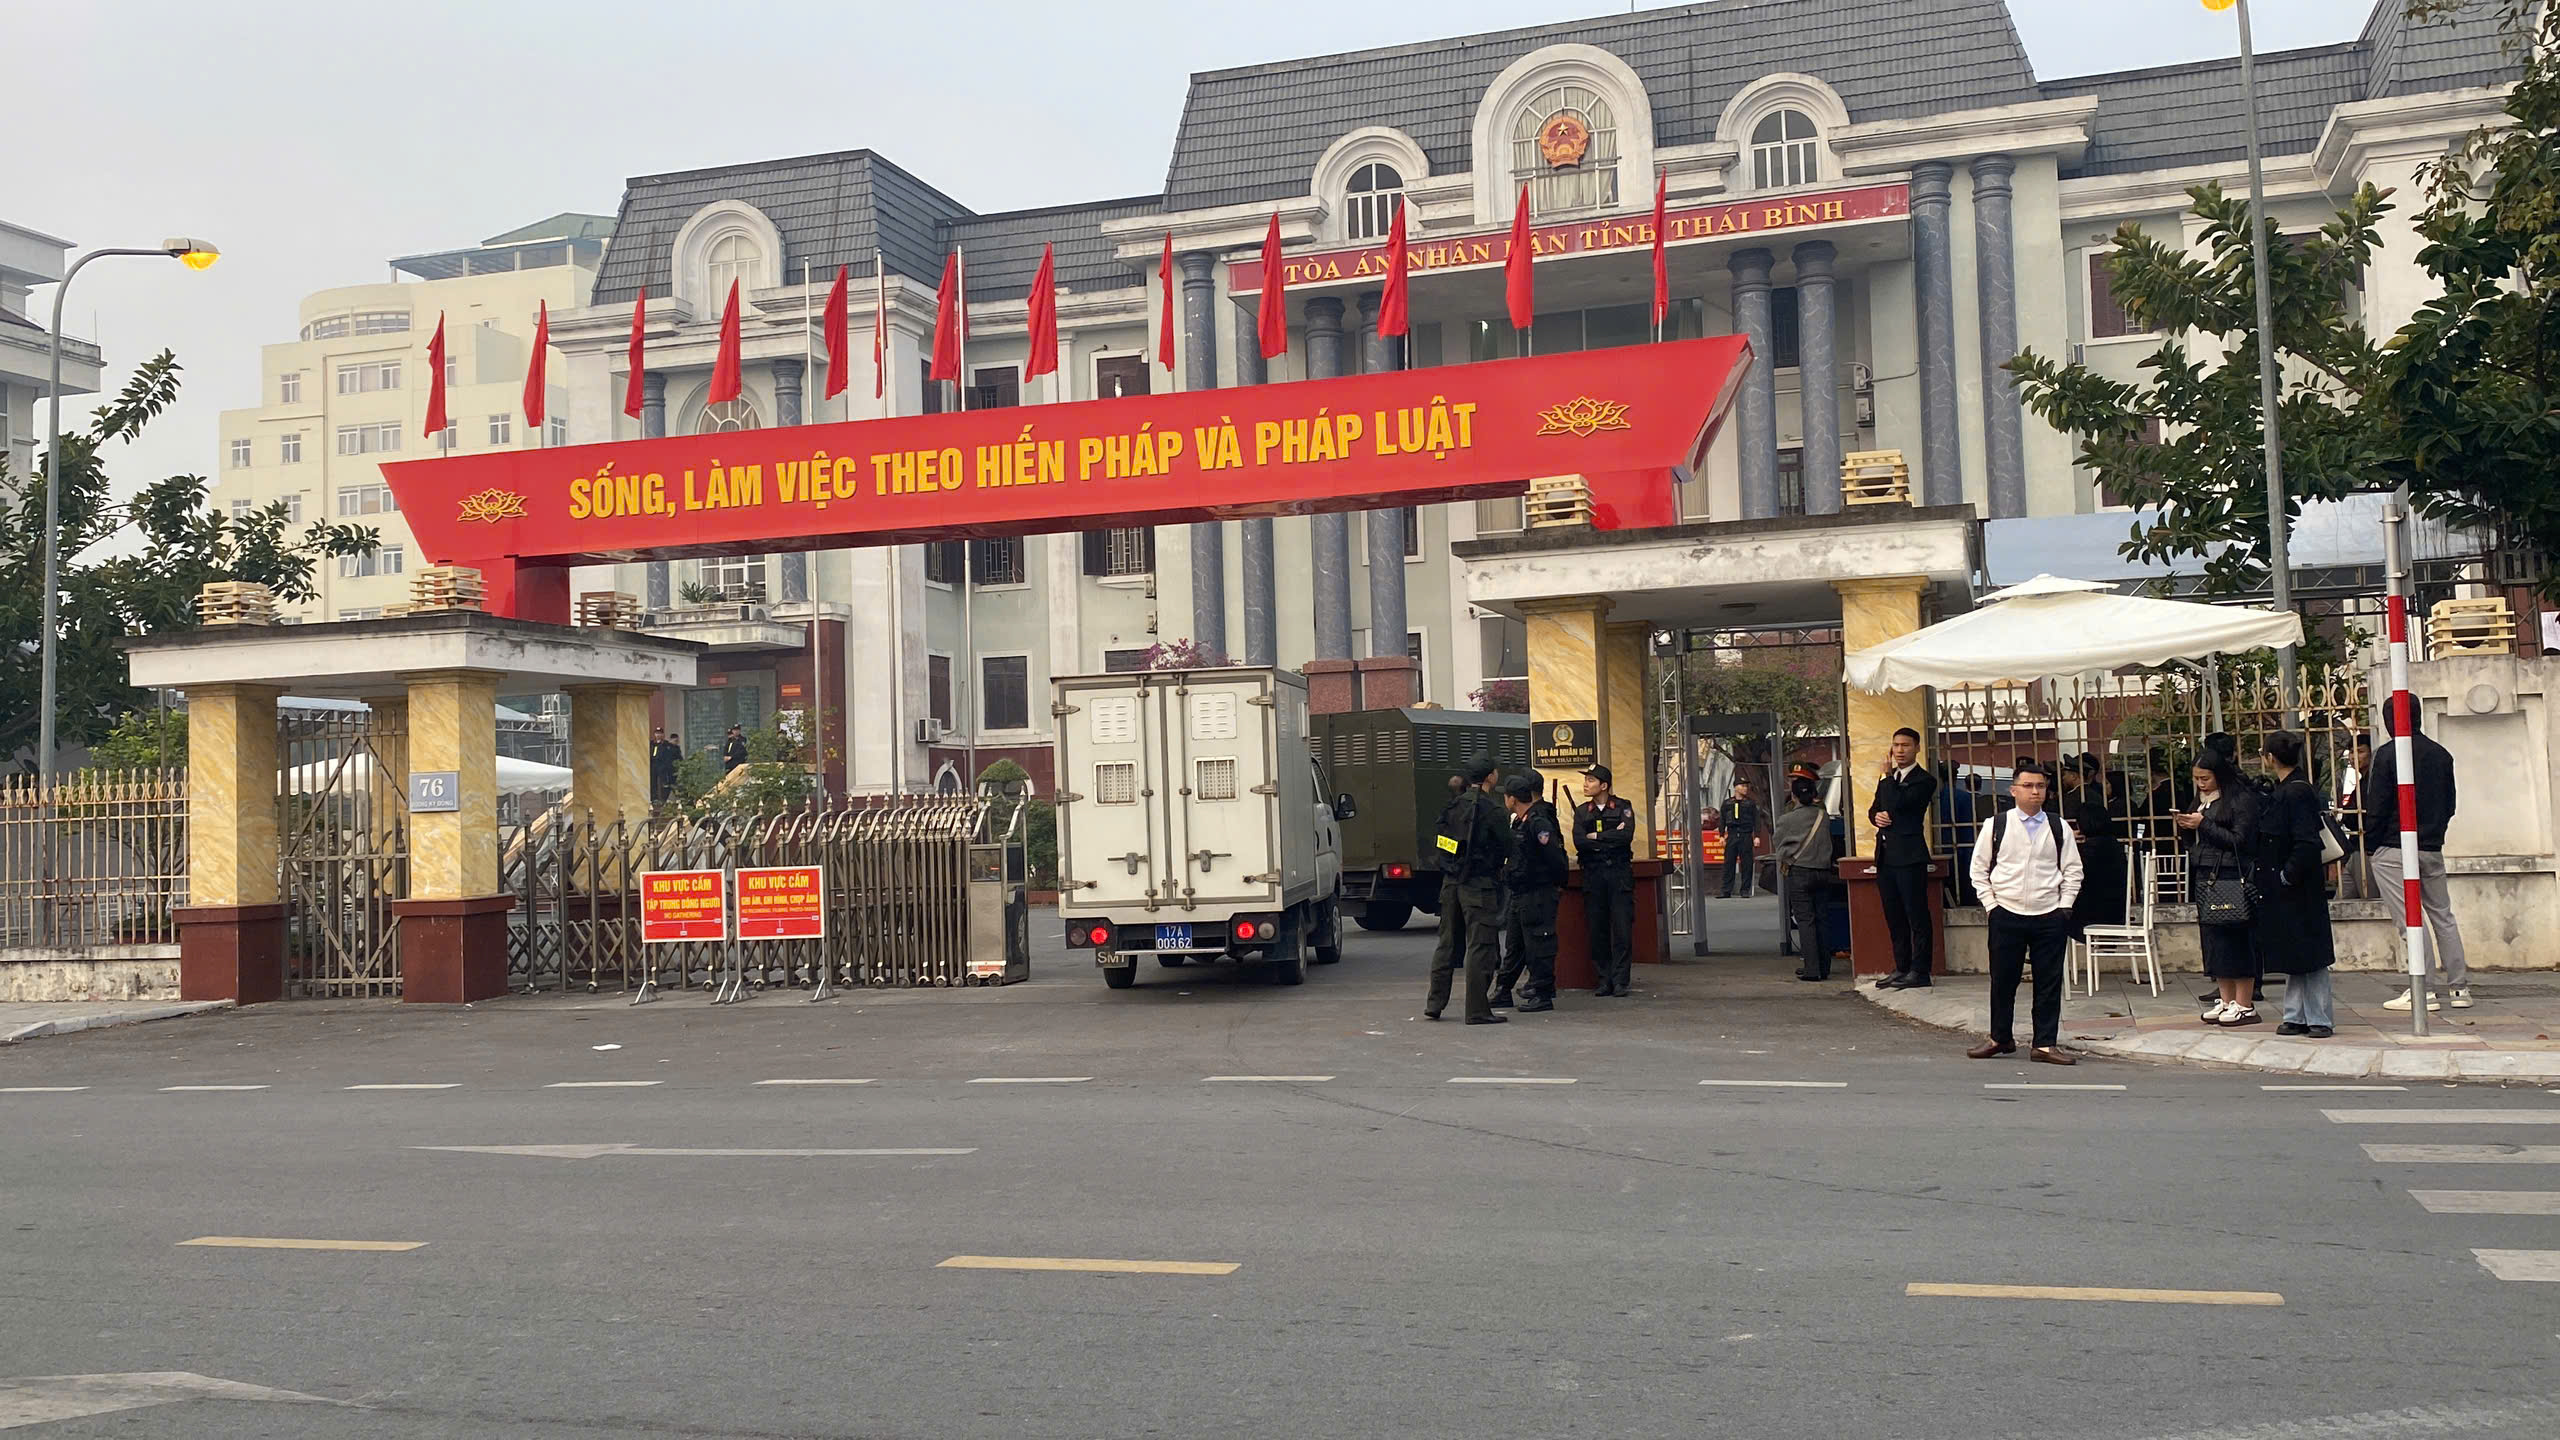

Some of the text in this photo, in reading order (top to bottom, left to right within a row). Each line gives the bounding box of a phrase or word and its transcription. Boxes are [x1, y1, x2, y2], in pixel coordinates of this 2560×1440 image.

[1284, 260, 1341, 283] TÒA
[1407, 240, 1490, 272] NHÂN
[1580, 220, 1656, 250] TỈNH
[1671, 207, 1750, 239] THÁI
[1763, 200, 1845, 229] BÌNH
[569, 396, 1478, 519] SỐNG, LÀM VIỆC THEO HIẾN PHÁP VÀ PHÁP LUẬT
[419, 778, 444, 797] 76
[653, 874, 712, 895] KHU VỰC CẤM
[748, 872, 809, 892] KHU VỰC CẤM
[659, 898, 681, 910] TRUNG
[1165, 926, 1183, 937] 17A
[1157, 937, 1191, 950] 003.62
[1097, 951, 1126, 963] SMT
